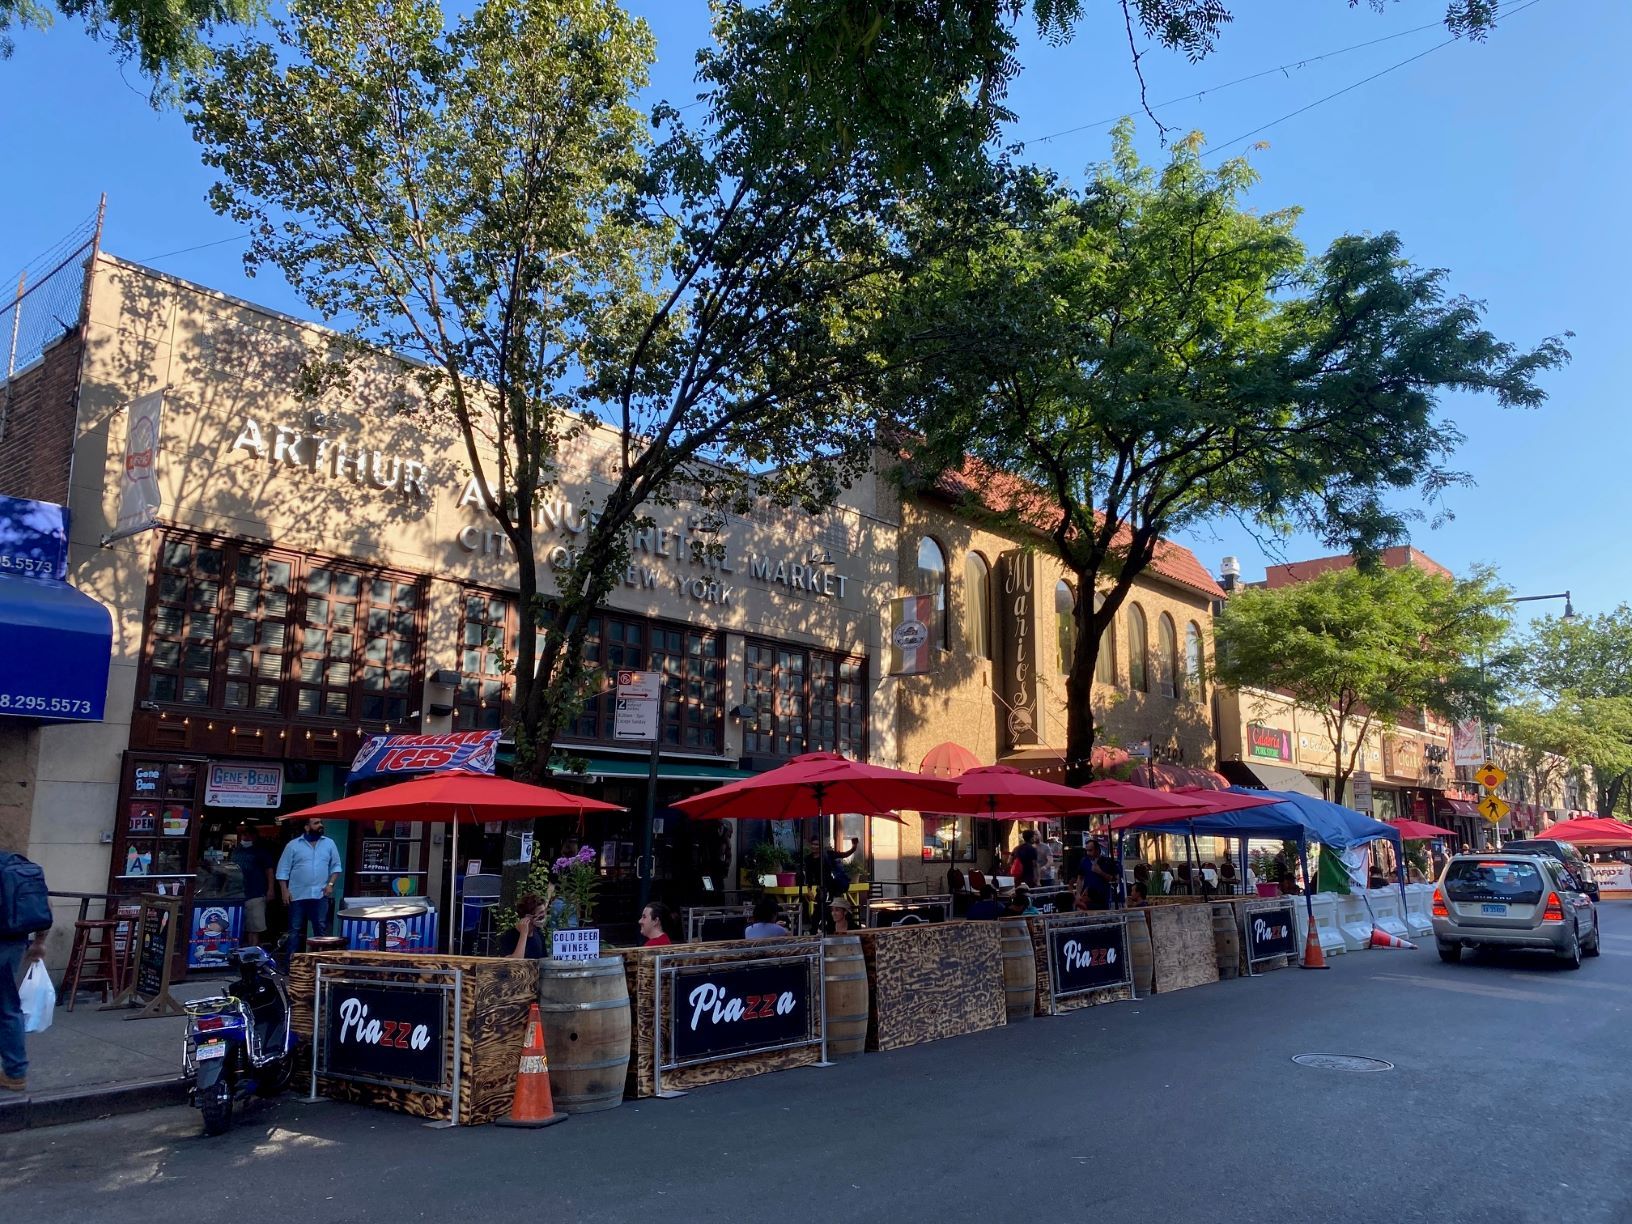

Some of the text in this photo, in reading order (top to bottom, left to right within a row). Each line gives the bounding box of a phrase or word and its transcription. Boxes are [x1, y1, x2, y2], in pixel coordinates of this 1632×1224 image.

[230, 417, 429, 497] ARTHUR
[455, 476, 605, 535] ANU
[748, 556, 849, 599] MARKET
[459, 525, 514, 557] CIT
[612, 561, 662, 590] EW
[676, 572, 734, 606] YORK
[1252, 727, 1280, 749] Calabria
[375, 745, 460, 773] ICES
[135, 767, 160, 779] Gene
[213, 767, 277, 786] GENE BEAN
[130, 857, 143, 873] A
[553, 931, 598, 942] COLD BEER
[1253, 918, 1289, 943] Piazza
[1063, 939, 1117, 972] Piazza
[688, 982, 797, 1031] Piazza
[340, 998, 431, 1051] Piazza
